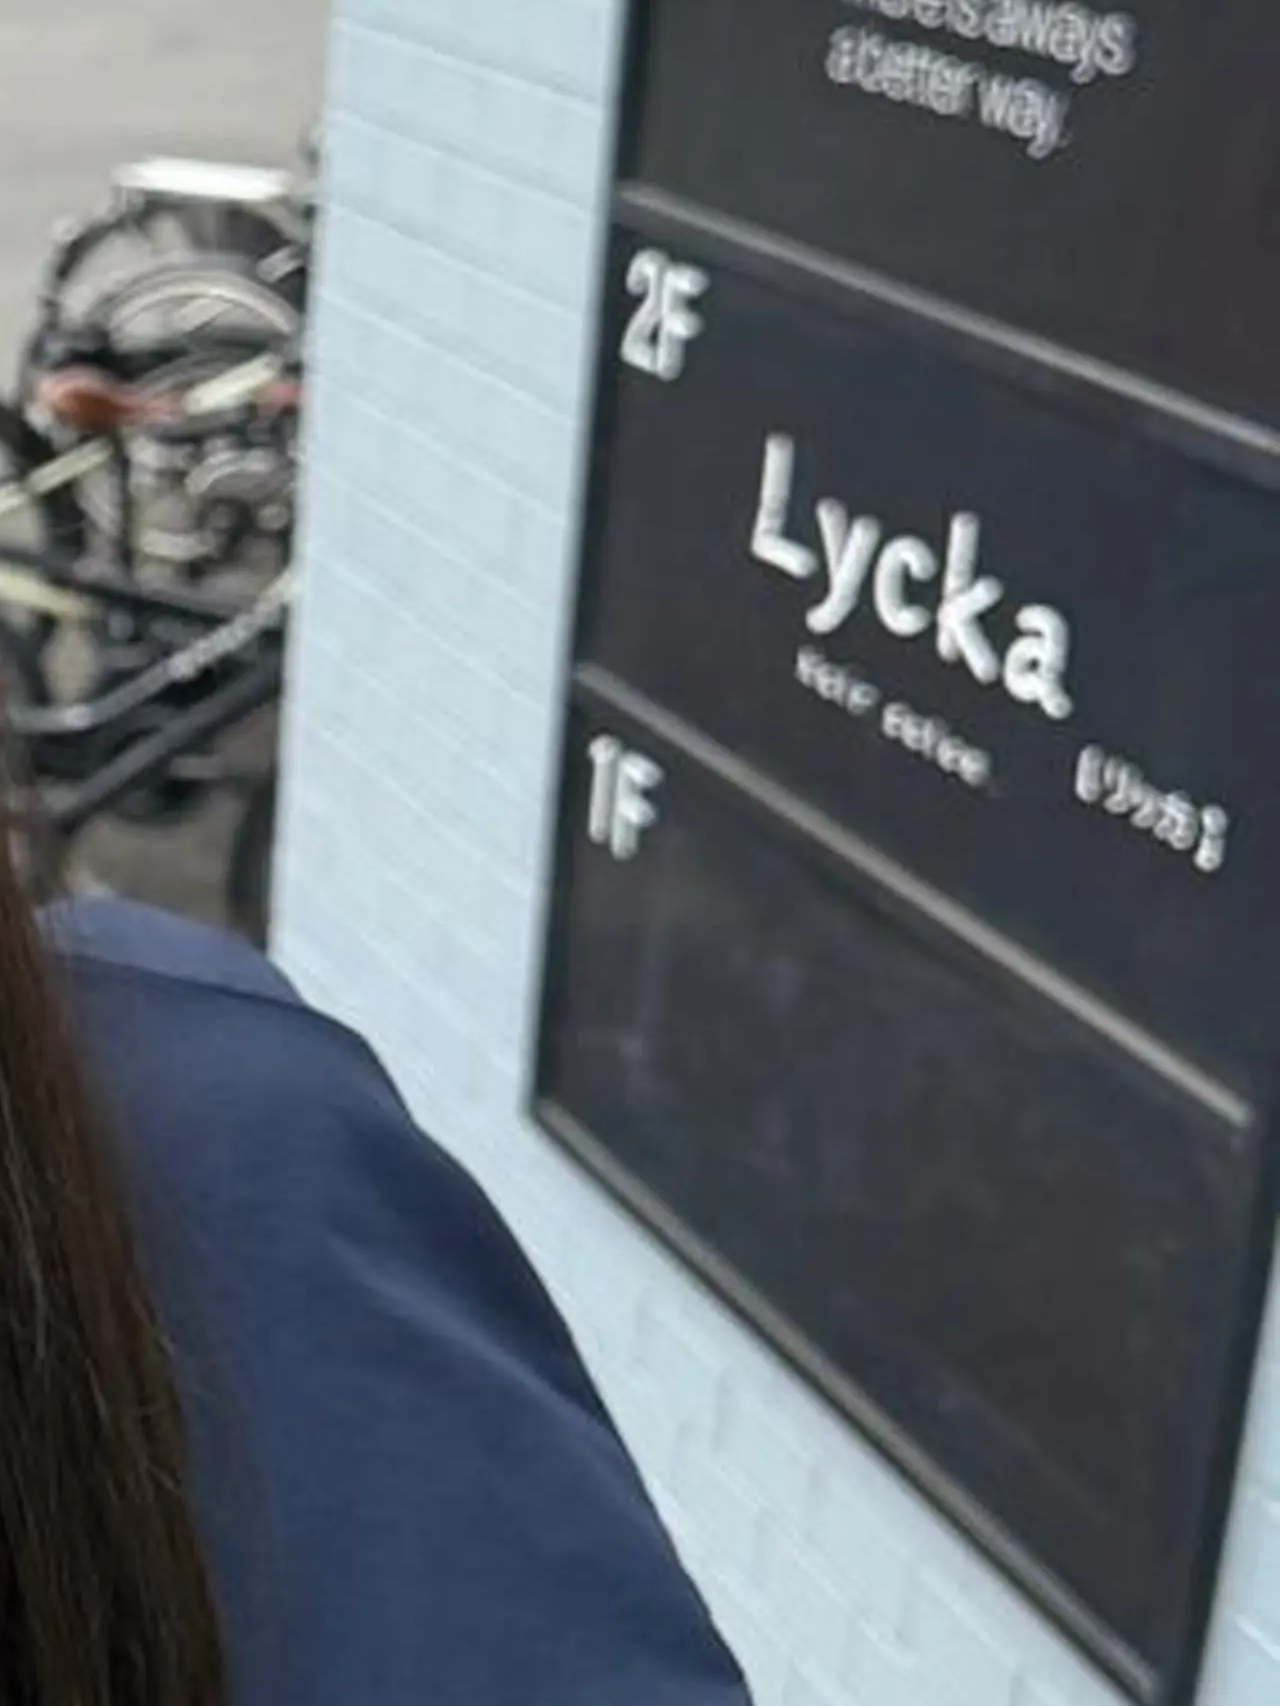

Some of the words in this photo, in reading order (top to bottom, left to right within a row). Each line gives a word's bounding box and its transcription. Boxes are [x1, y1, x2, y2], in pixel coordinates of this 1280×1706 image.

[620, 248, 710, 382] 2F
[751, 433, 1074, 720] Lycka
[588, 733, 666, 861] 1F
